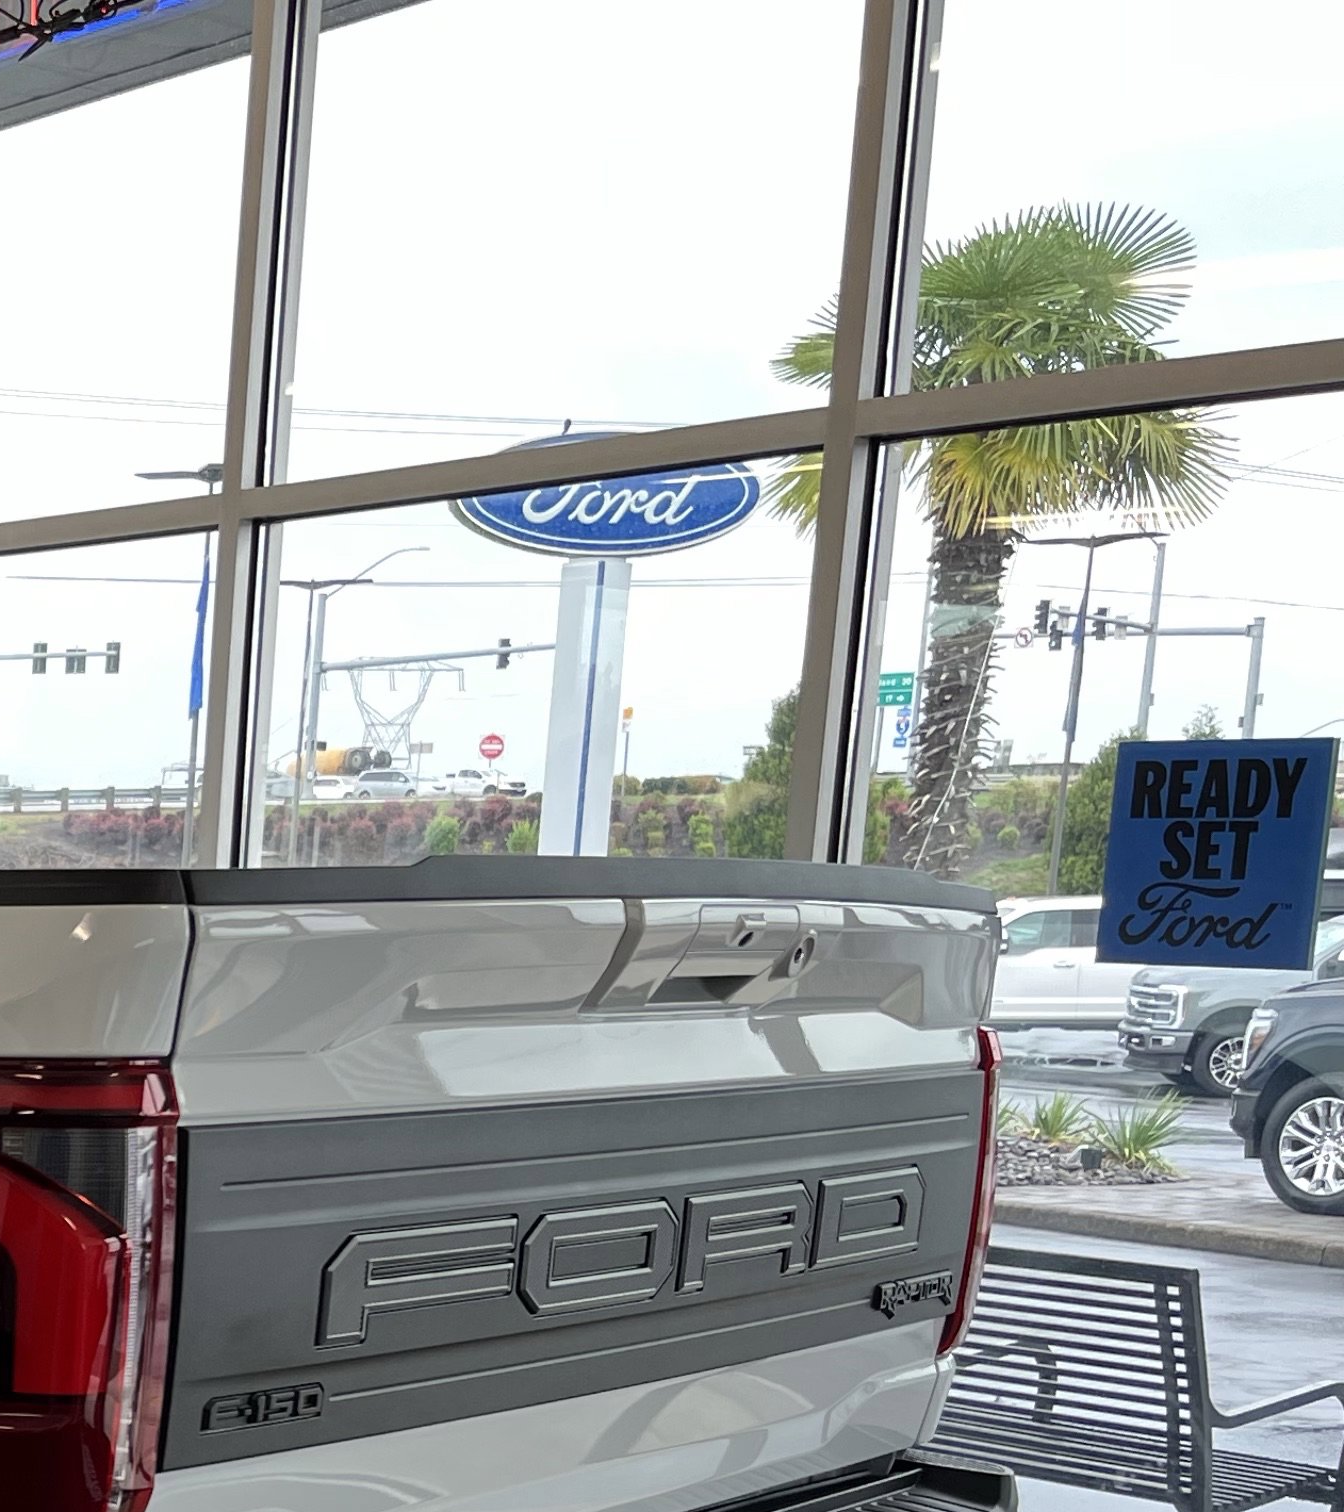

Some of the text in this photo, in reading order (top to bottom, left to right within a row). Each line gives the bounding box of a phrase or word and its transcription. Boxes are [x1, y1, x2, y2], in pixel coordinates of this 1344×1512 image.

[1130, 757, 1308, 818] READY
[1159, 821, 1259, 880] SET
[1118, 882, 1279, 950] Ford
[314, 1164, 928, 1350] FORD
[874, 1269, 952, 1317] RAPTOR
[201, 1383, 324, 1435] F-150
